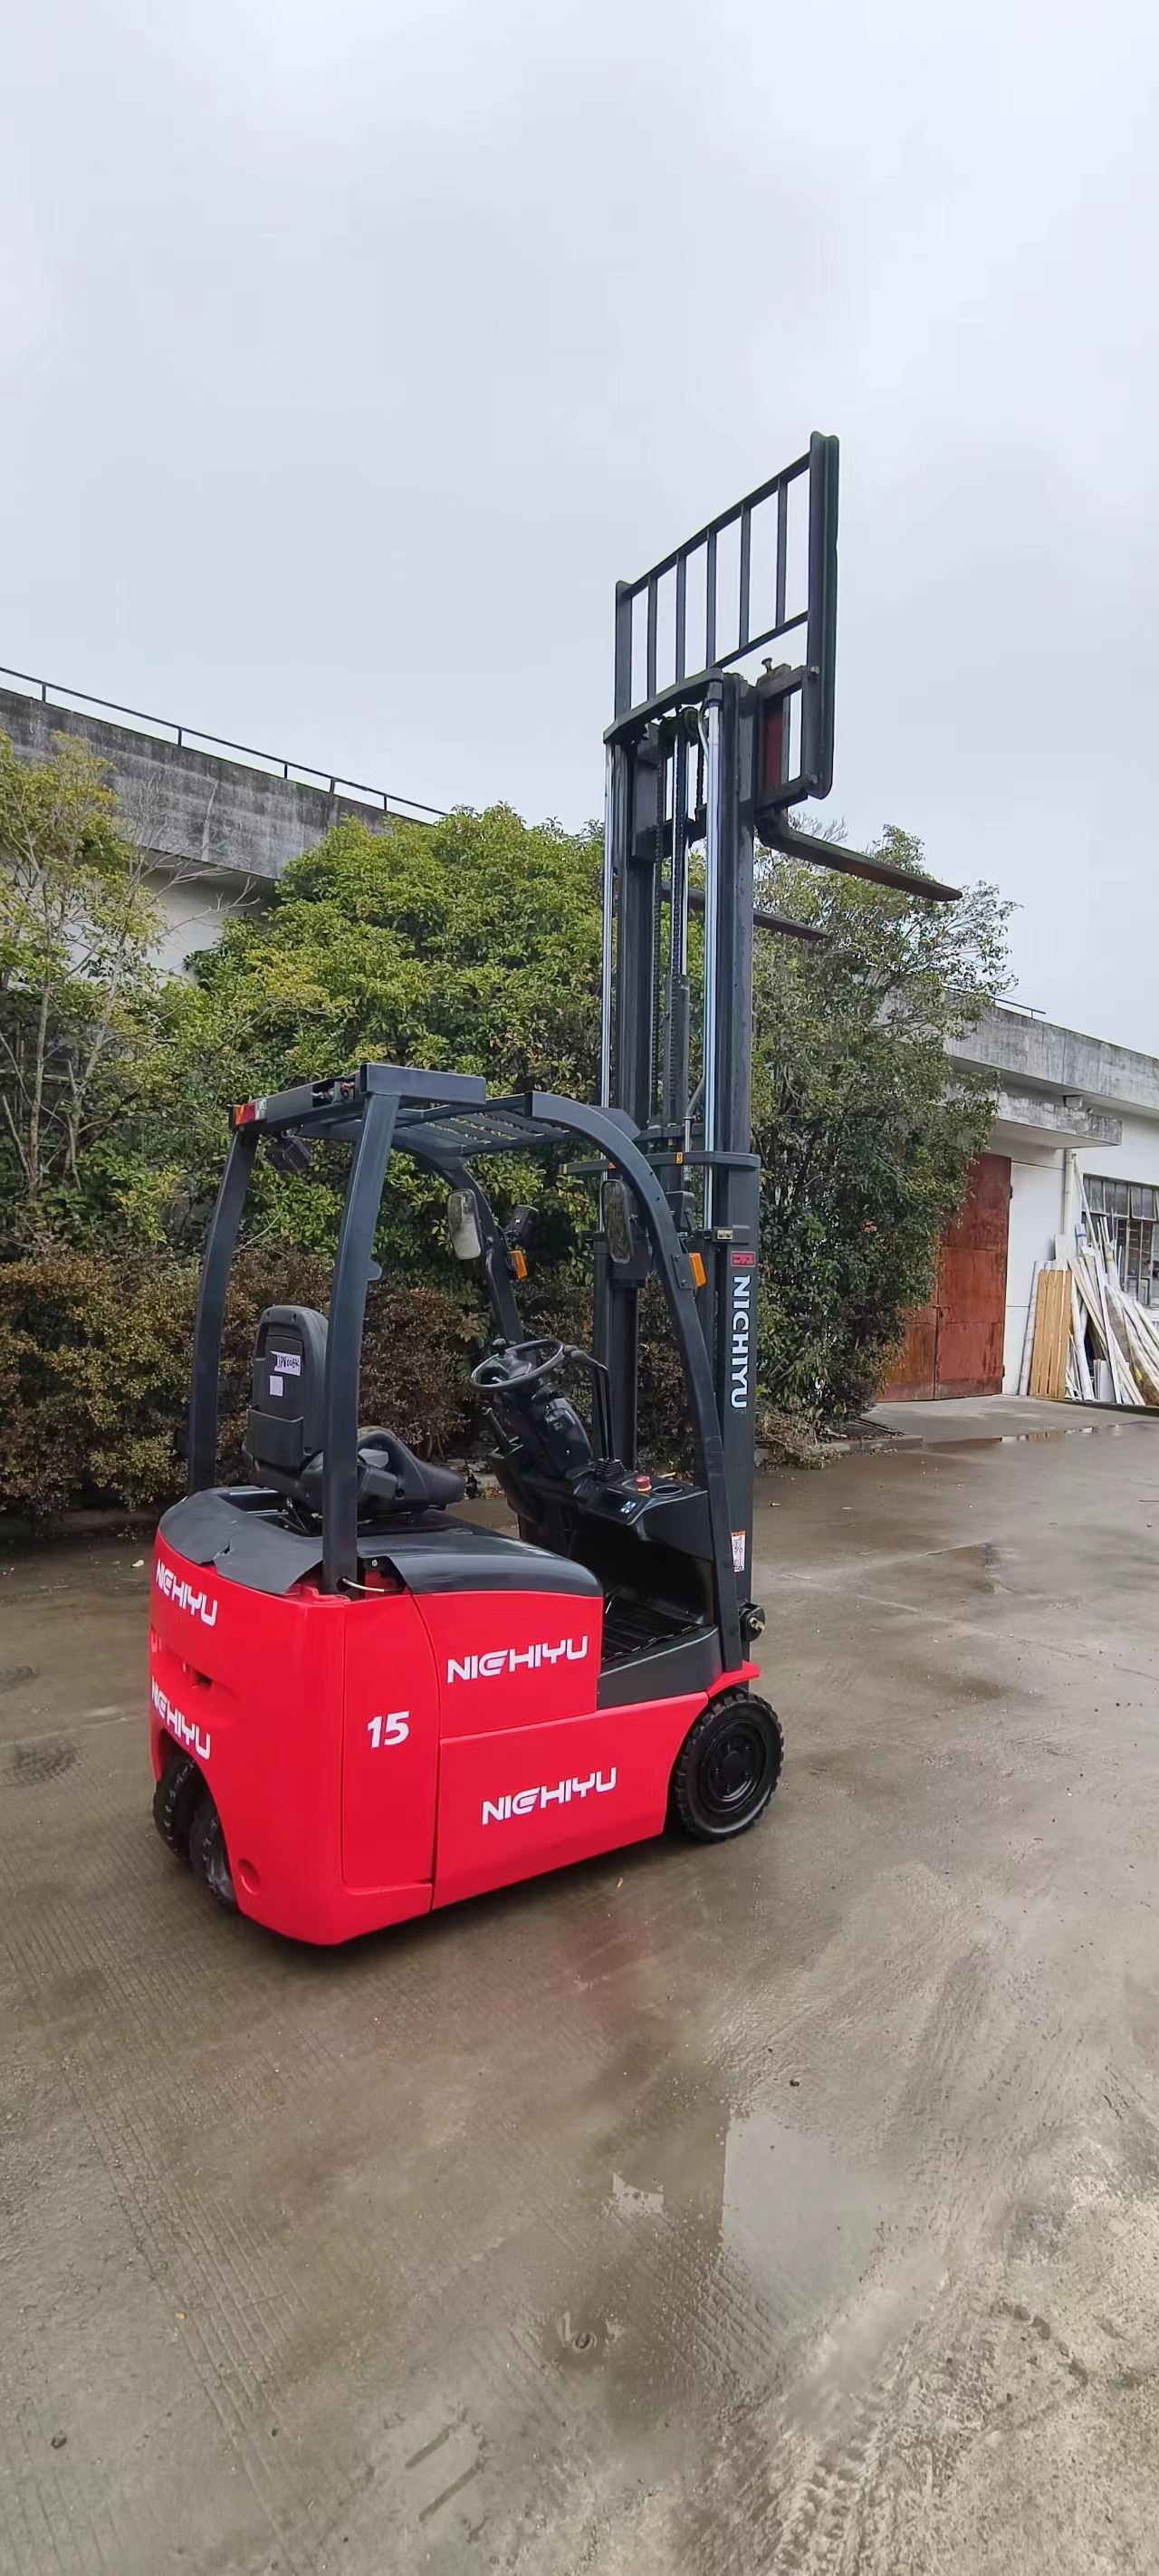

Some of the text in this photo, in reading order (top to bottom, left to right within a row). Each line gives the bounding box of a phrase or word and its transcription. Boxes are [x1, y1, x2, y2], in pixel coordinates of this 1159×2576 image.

[731, 1274, 751, 1408] NICHIYU
[156, 1558, 218, 1627] NICHIYU
[446, 1635, 589, 1684] NICHIYU
[151, 1677, 211, 1760] NICHIYU
[367, 1710, 410, 1748] 15
[482, 1767, 617, 1825] NICHIYU
